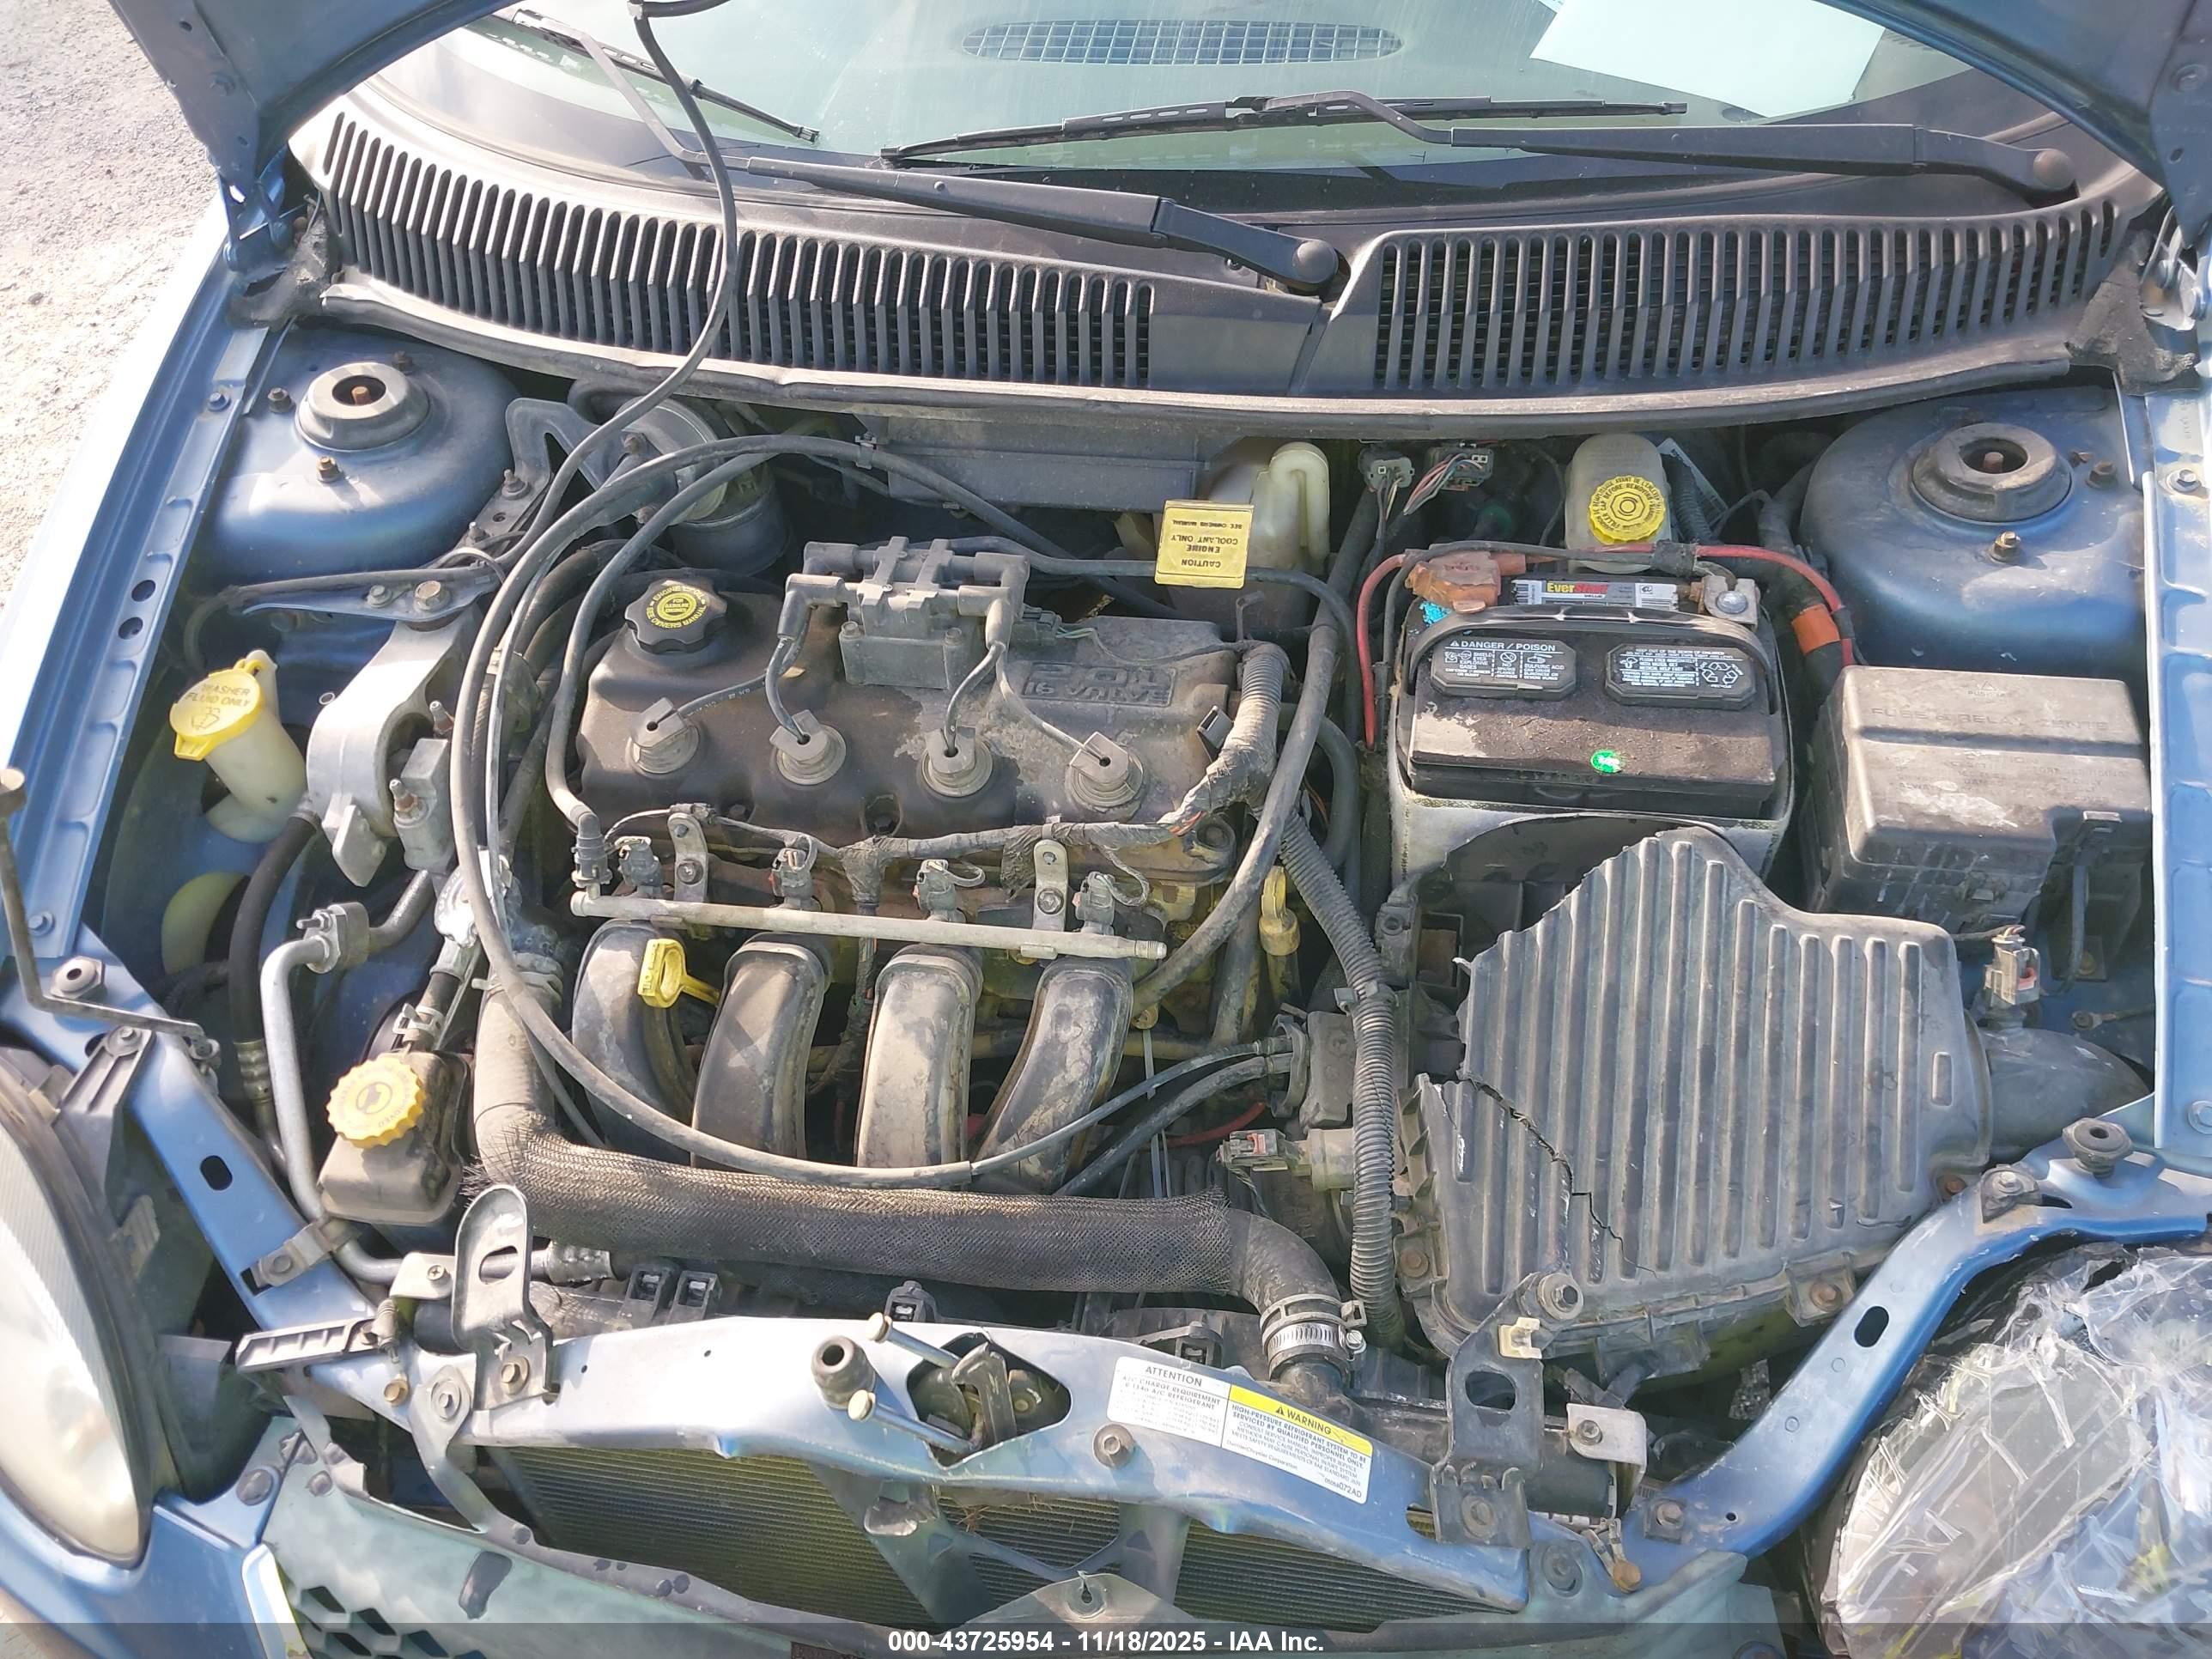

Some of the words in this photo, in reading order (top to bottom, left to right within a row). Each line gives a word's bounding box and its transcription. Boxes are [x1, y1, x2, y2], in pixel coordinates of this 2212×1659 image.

[1602, 483, 1623, 500] BEFORE
[1170, 534, 1194, 543] ONLY
[1197, 536, 1239, 545] COOLANT
[1186, 544, 1220, 553] ENGINE
[1181, 559, 1221, 568] CAUTION
[653, 586, 681, 601] ENGINE
[682, 605, 707, 626] MANUAL
[1461, 641, 1504, 649] DANGER
[1516, 644, 1556, 652] POISON
[1023, 681, 1055, 695] 16
[1145, 1366, 1203, 1388] ATTENTION
[1139, 1378, 1170, 1390] CHARGE
[1172, 1386, 1220, 1406] REQUIREMENT
[1168, 1391, 1215, 1410] REFRIGERANT
[1287, 1409, 1332, 1435] WARNING
[1232, 1404, 1281, 1426] HIGH-PRESSURE
[1284, 1423, 1325, 1445] REFRIGERANT
[1327, 1441, 1348, 1455] SYSTEM
[1351, 1451, 1358, 1459] TO
[1359, 1455, 1366, 1464] BE
[1233, 1412, 1265, 1427] SERVICED
[1267, 1423, 1275, 1431] BY
[1277, 1427, 1310, 1445] QUALIFIED
[1310, 1441, 1345, 1462] PERSONNEL
[1347, 1456, 1364, 1469] ONLY.
[1231, 1428, 1249, 1441] MEETS
[1268, 1443, 1305, 1463] REQUIREMENTS
[1265, 1429, 1286, 1442] SERVICE
[1337, 1460, 1357, 1473] SERVICE
[1277, 1441, 1293, 1452] CAUSE
[1295, 1448, 1320, 1463] PERSONAL
[1268, 1455, 1298, 1470] Corporation
